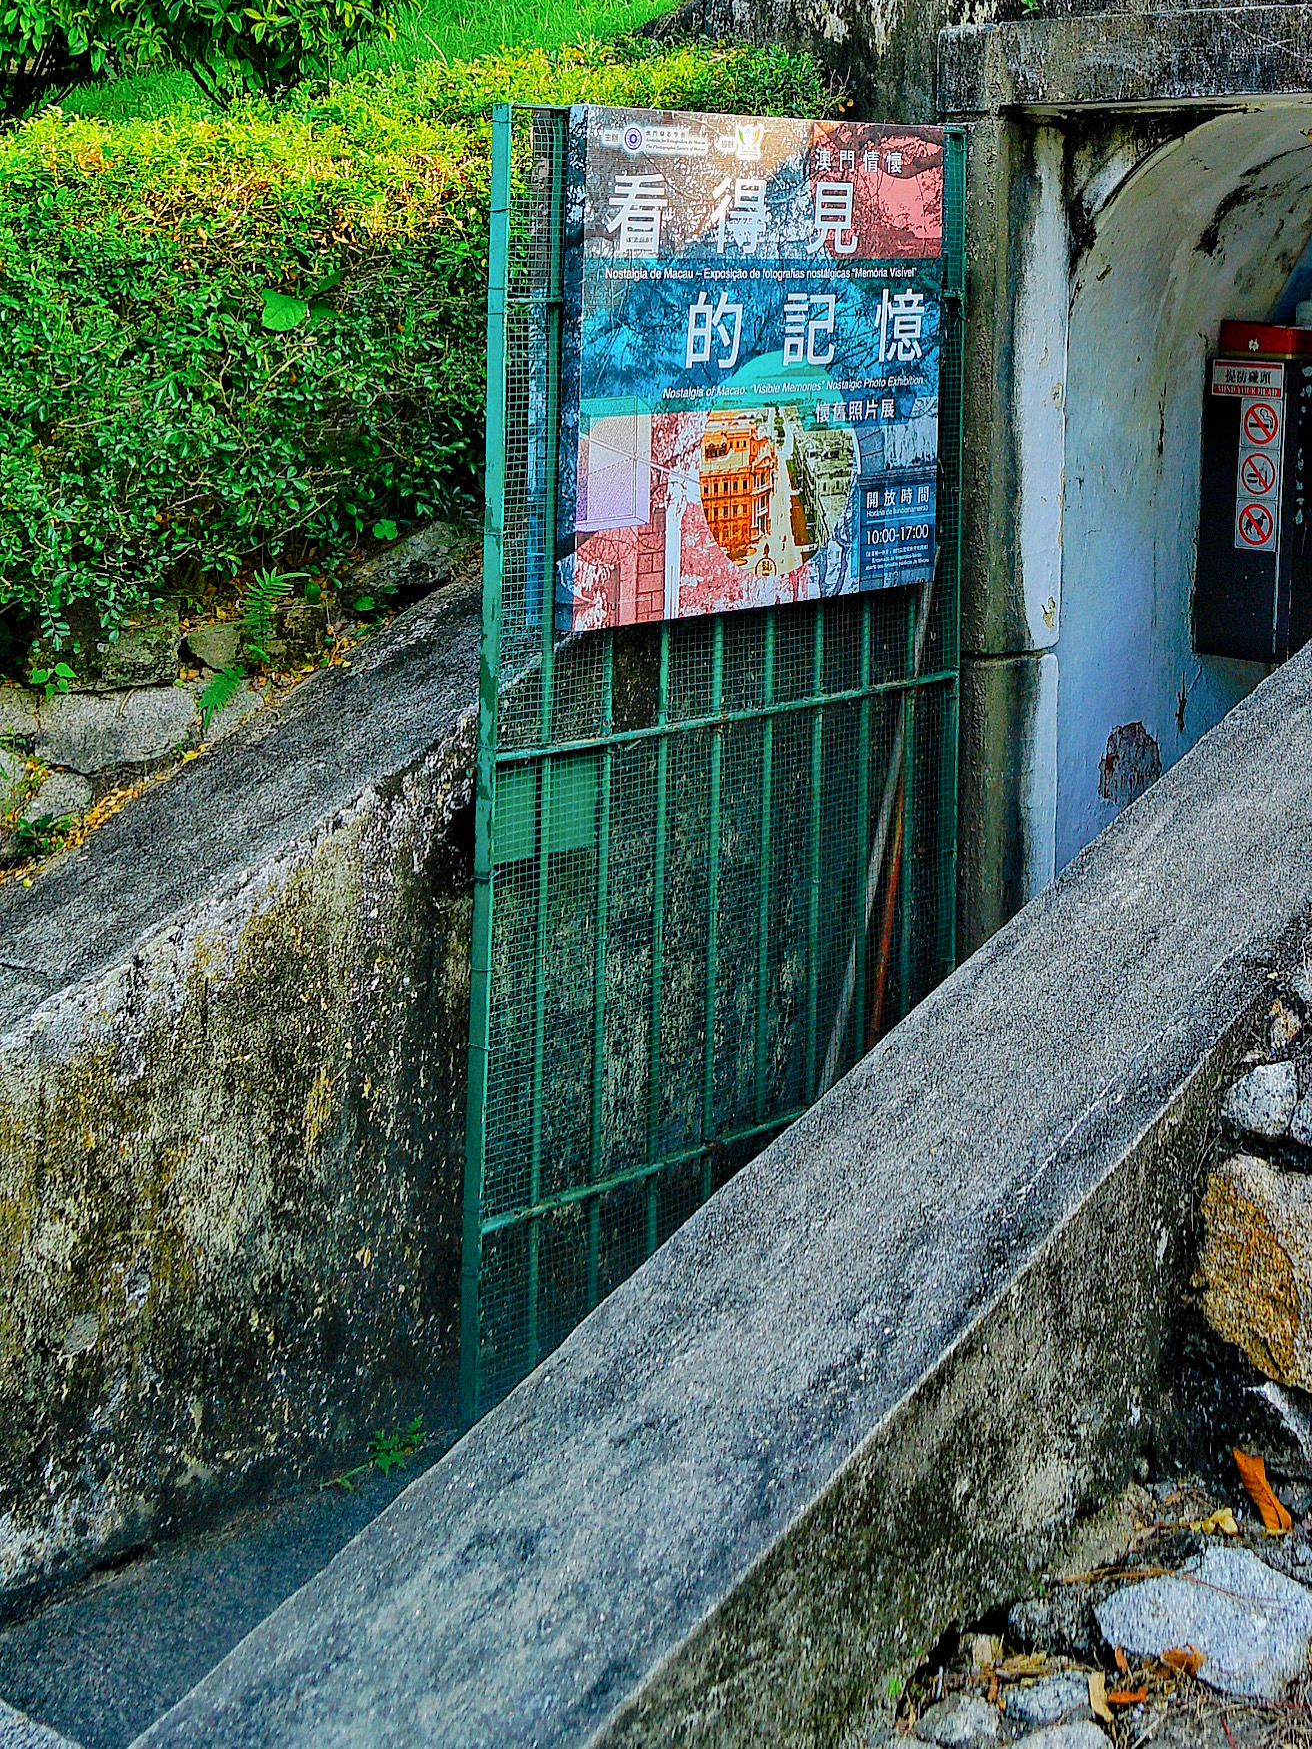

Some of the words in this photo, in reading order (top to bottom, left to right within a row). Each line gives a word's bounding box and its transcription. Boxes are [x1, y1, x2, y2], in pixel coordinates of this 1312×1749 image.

[814, 149, 902, 174] 澳門情懷
[606, 173, 858, 254] 看得見
[605, 268, 648, 281] Nostalgia
[650, 268, 662, 279] de
[663, 269, 694, 279] Macau
[704, 268, 748, 281] Exposição
[750, 269, 761, 279] de
[686, 287, 926, 369] 的記憶
[662, 386, 703, 400] Nostalgia
[705, 386, 716, 396] of
[826, 378, 862, 392] Nostalgic
[863, 377, 886, 388] Photo
[887, 375, 923, 387] Exhibition
[815, 398, 895, 423] 懷舊照片展
[866, 485, 930, 510] 開放時間
[866, 523, 929, 545] 10:00-17:00
